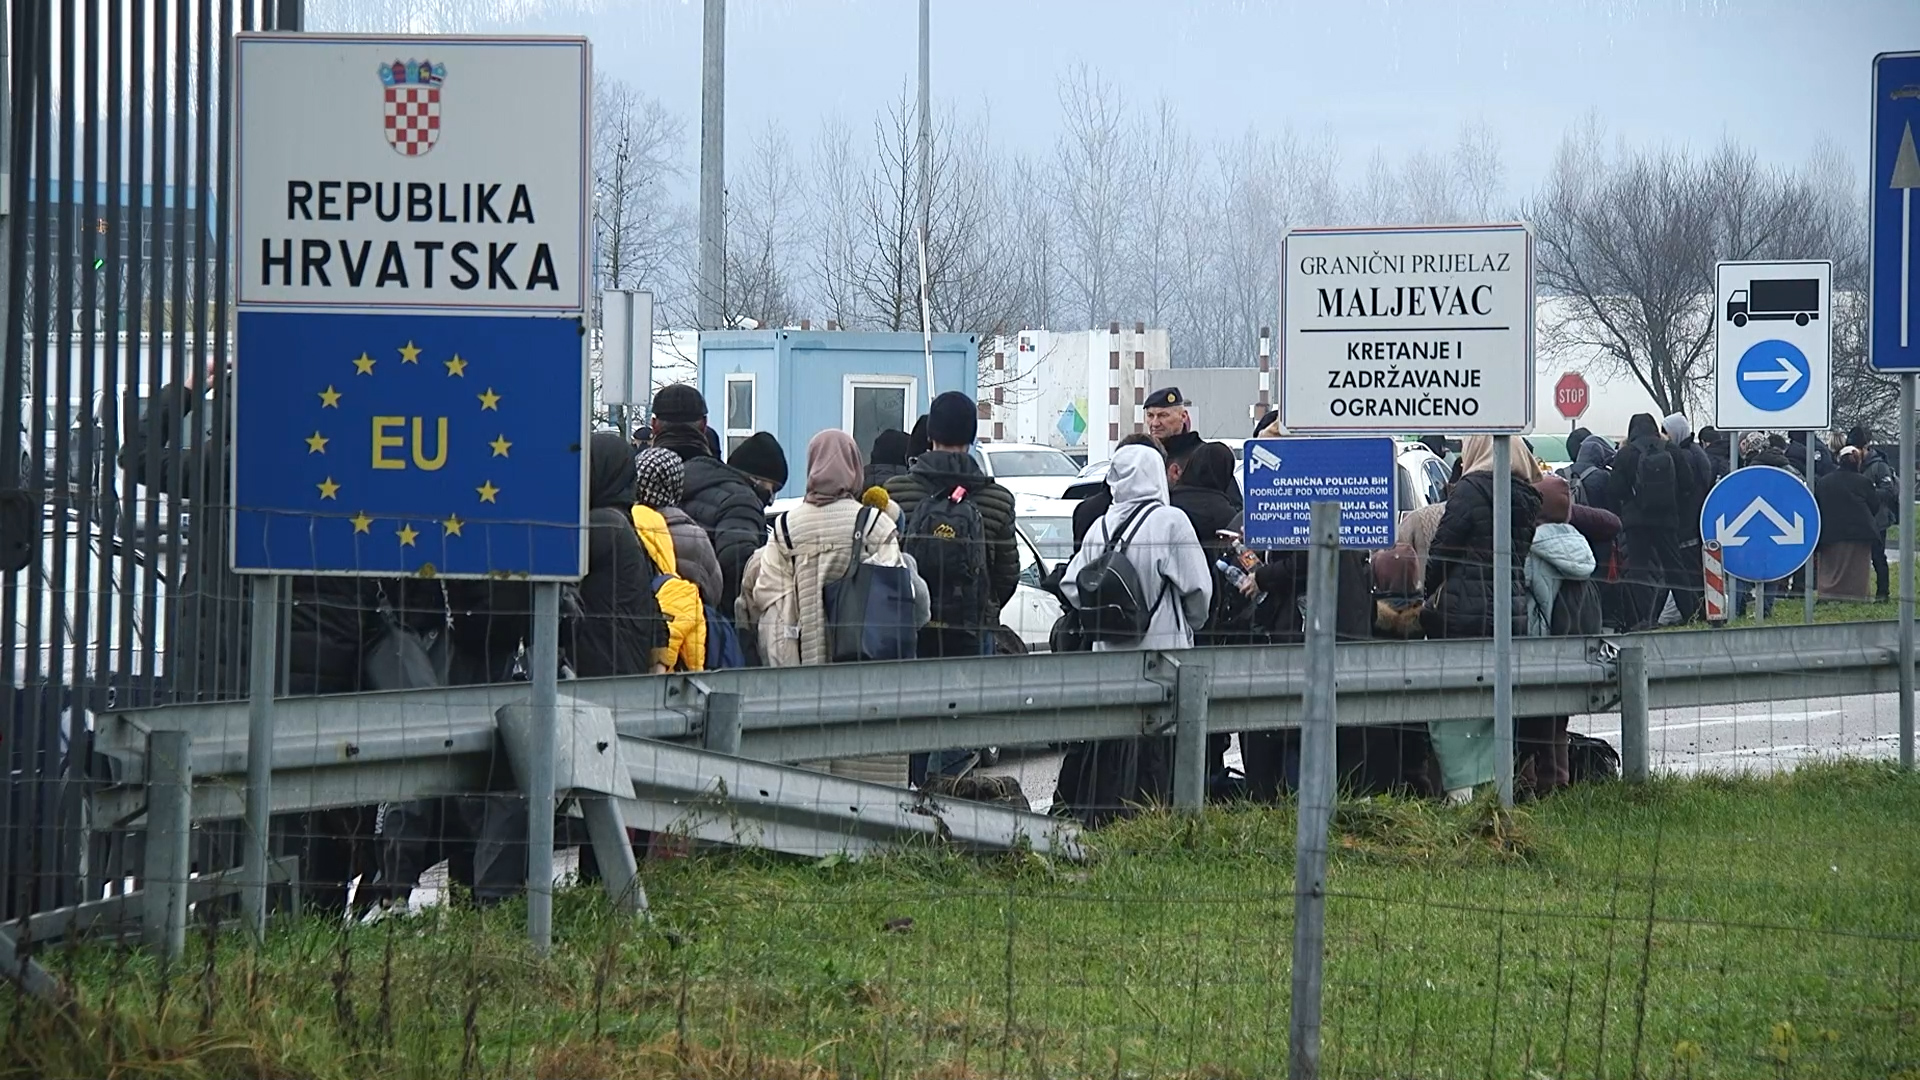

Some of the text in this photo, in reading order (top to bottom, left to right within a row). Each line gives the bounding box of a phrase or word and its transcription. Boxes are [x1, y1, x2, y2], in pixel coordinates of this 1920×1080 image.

[287, 180, 536, 224] REPUBLIKA
[262, 238, 560, 291] HRVATSKA
[1300, 250, 1511, 275] GRANIČNI PRIJELAZ
[1316, 284, 1494, 318] MALJEVAC
[1347, 341, 1463, 361] KRETANJE I
[1328, 364, 1482, 389] ZADRŽAVANJE
[1330, 393, 1480, 417] OGRANIČENO
[1559, 388, 1584, 403] STOP
[371, 416, 449, 472] EU
[1250, 486, 1389, 496] PODRUČJE POD VIDEO NADZOROM
[1273, 476, 1388, 486] GRANIČNA POLICIJA BiH
[1250, 511, 1389, 521] ПОДРУЧЈЕ ПОД НАДЗОРОМ
[1258, 502, 1311, 511] ГРАНИЧНА
[1369, 501, 1389, 510] БиХ
[1293, 526, 1310, 535] BiH
[1353, 525, 1389, 534] POLICE
[1273, 537, 1301, 545] UNDER
[1338, 536, 1389, 545] RVEILLANCE
